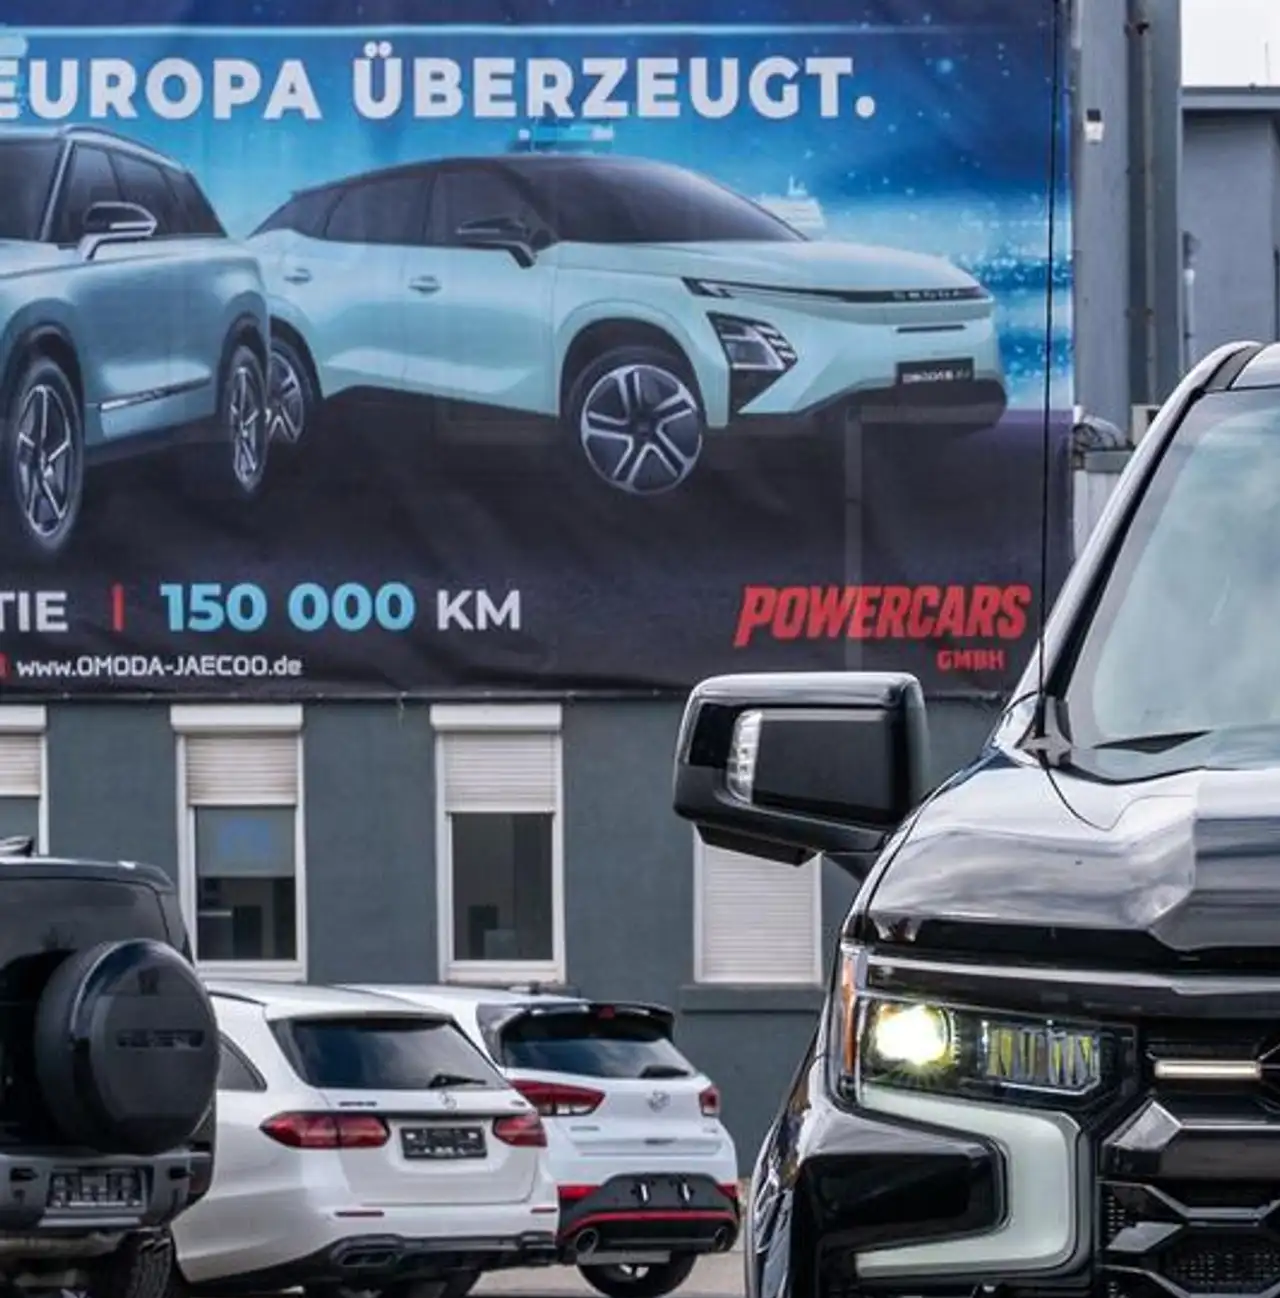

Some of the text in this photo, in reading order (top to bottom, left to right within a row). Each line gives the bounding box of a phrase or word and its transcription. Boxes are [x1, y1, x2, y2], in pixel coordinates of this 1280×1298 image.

[352, 41, 877, 119] ÜBERZEUGT.
[160, 582, 268, 632] 150
[288, 582, 416, 632] 000
[437, 589, 521, 632] KM
[733, 585, 1032, 647] POWERCARS
[16, 655, 303, 677] www.OMODA-JAECOO.de
